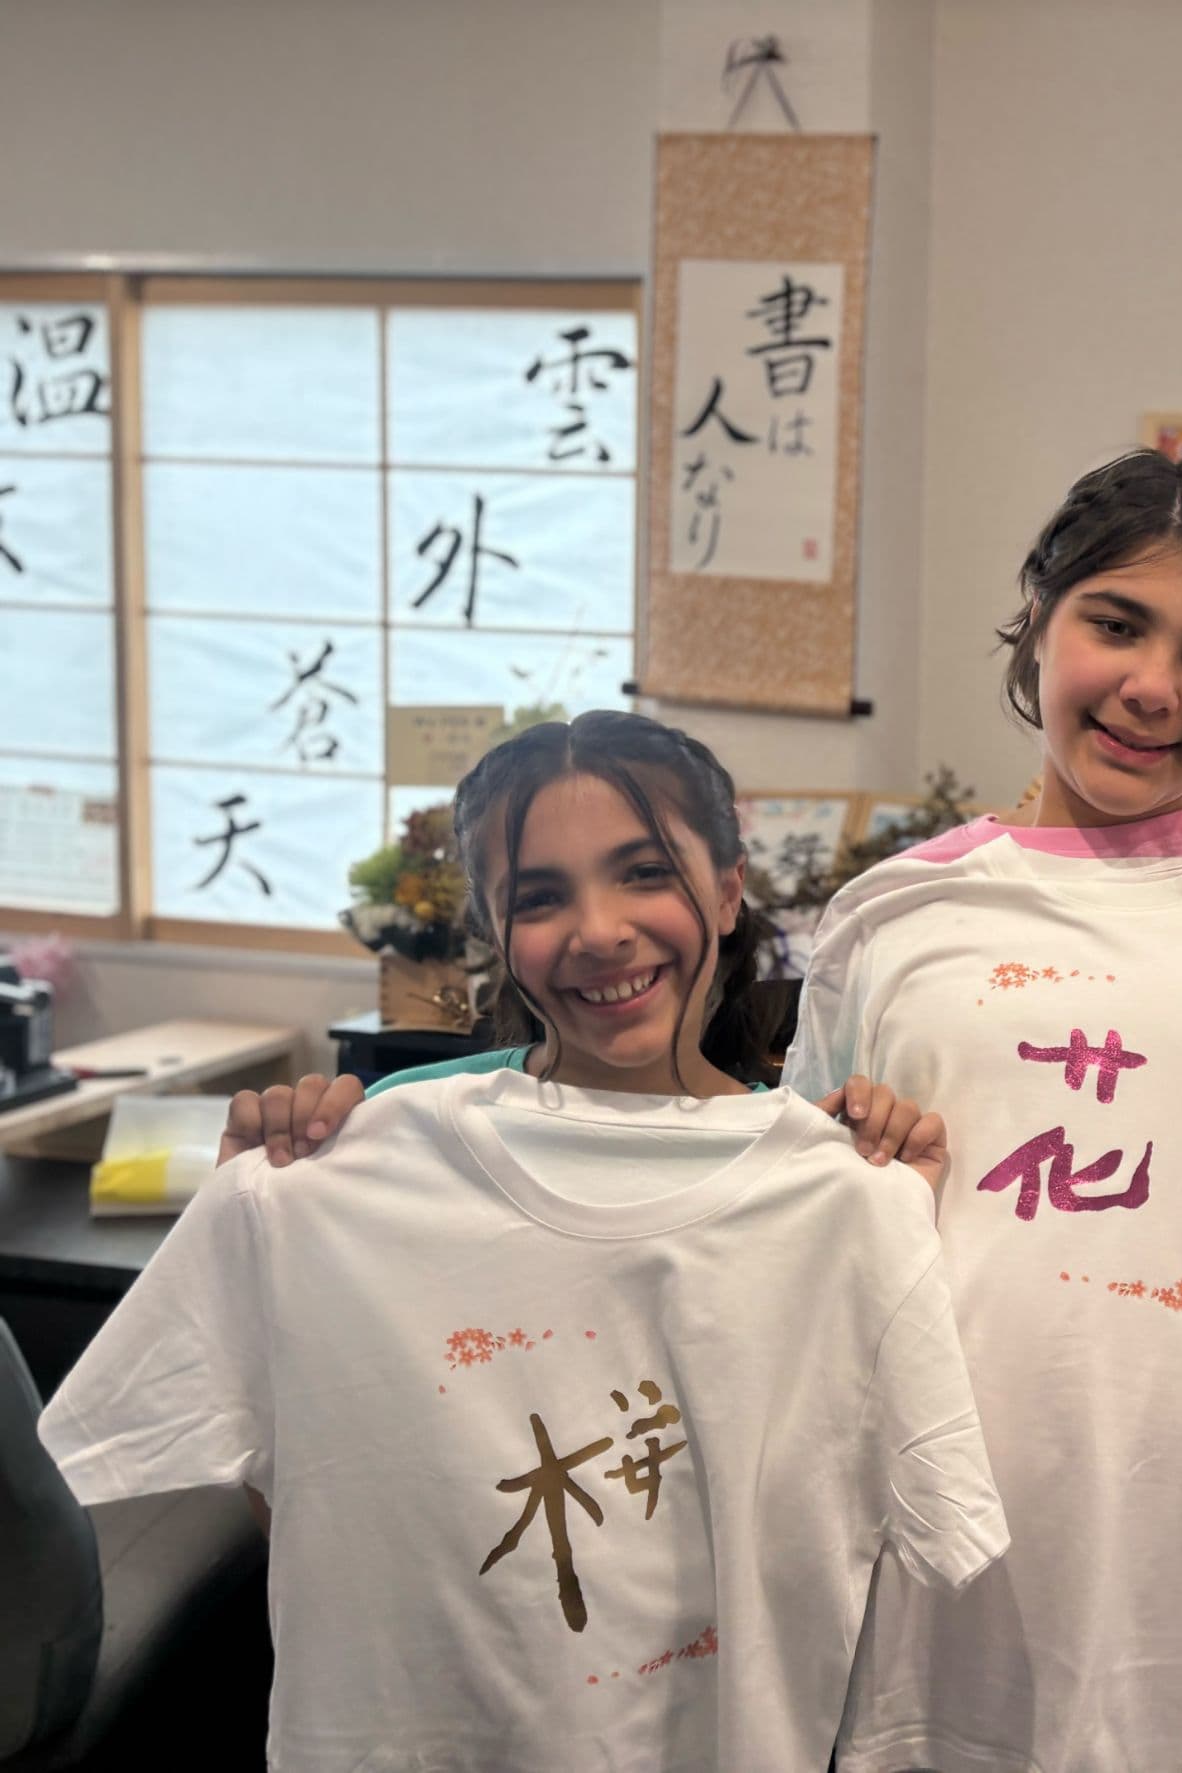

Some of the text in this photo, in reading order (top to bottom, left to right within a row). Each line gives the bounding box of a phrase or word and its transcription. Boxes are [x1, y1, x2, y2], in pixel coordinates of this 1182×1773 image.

[744, 275, 832, 455] 書は
[682, 378, 757, 568] 人なり
[976, 1028, 1153, 1221] 花
